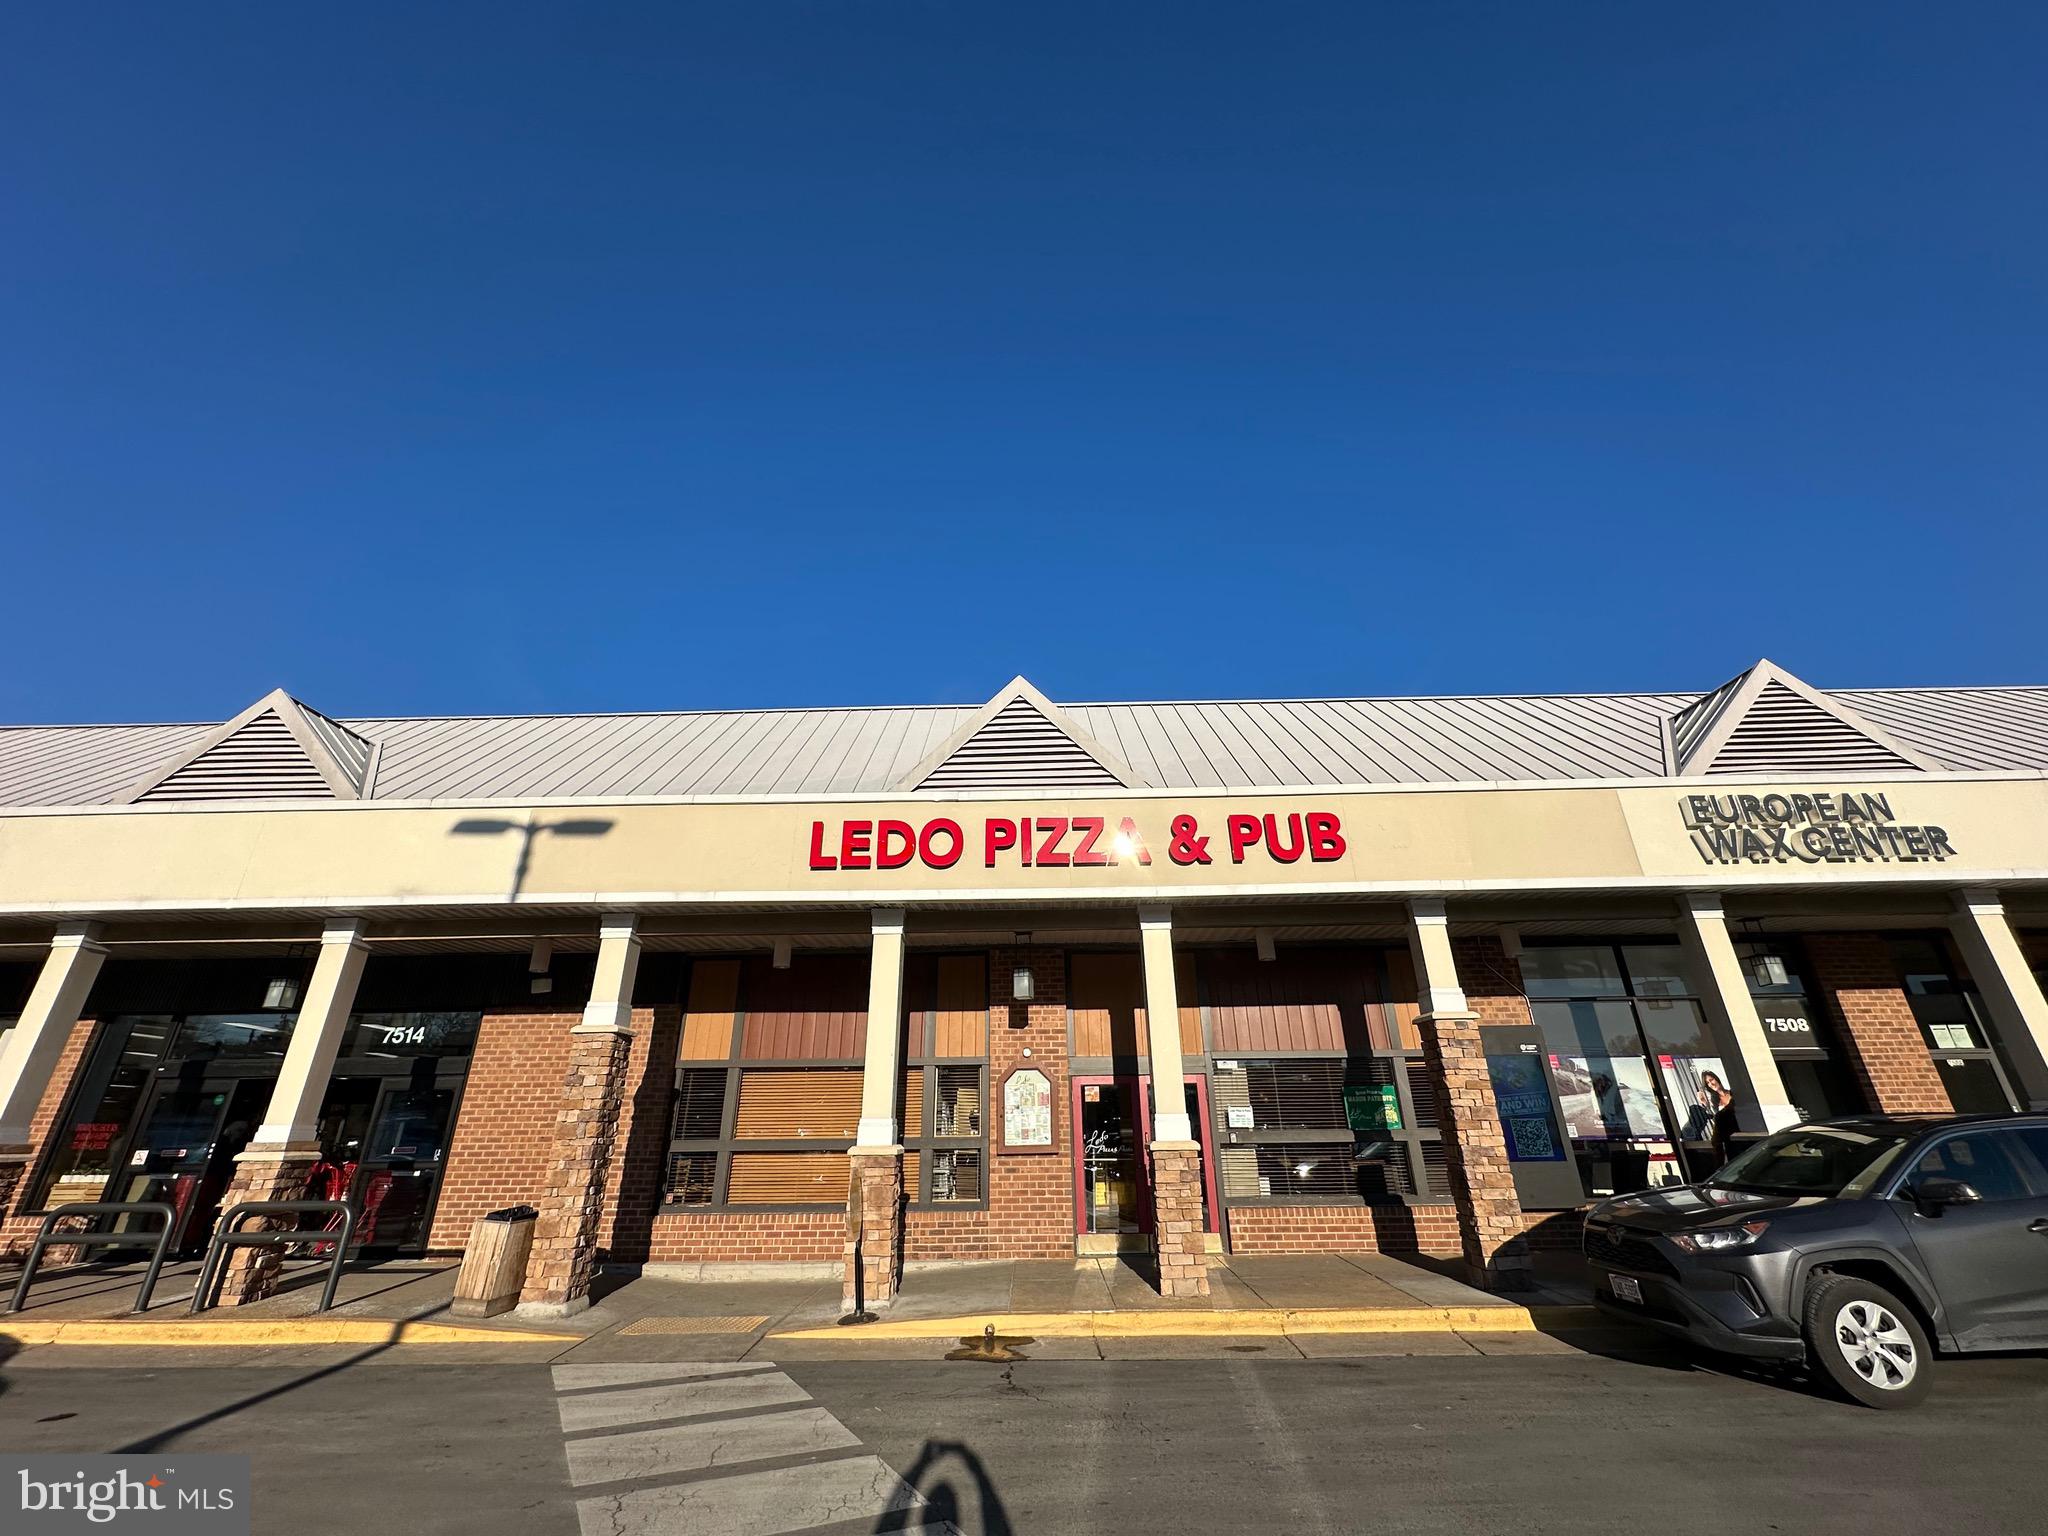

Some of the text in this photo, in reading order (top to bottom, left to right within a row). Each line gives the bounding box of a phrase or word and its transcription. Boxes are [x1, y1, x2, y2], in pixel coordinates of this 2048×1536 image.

[1681, 793, 1895, 826] EUROPEAN
[809, 812, 1346, 870] LEDO PIZZA & PUB
[1692, 825, 1957, 862] WAX CENTER
[382, 1026, 425, 1044] 7514
[1765, 1018, 1809, 1032] 7508
[1500, 1100, 1522, 1110] AND
[1525, 1098, 1547, 1108] WIN
